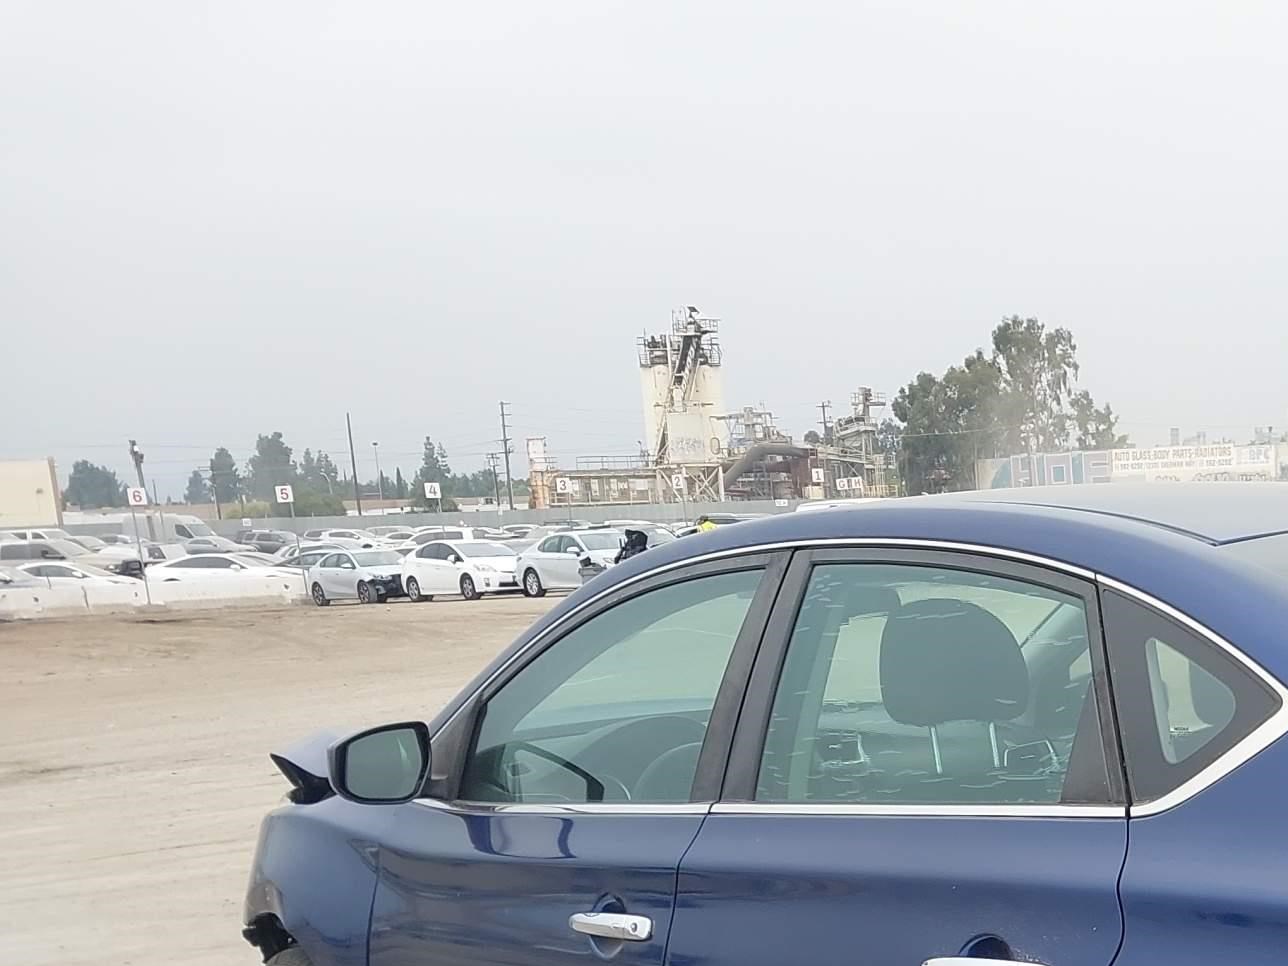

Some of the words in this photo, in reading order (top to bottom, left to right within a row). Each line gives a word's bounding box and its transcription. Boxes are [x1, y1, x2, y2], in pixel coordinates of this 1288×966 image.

[815, 470, 822, 480] 1
[559, 479, 567, 491] 3
[674, 476, 681, 487] 2
[132, 490, 143, 503] 6
[280, 488, 289, 500] 5
[428, 484, 437, 497] 4
